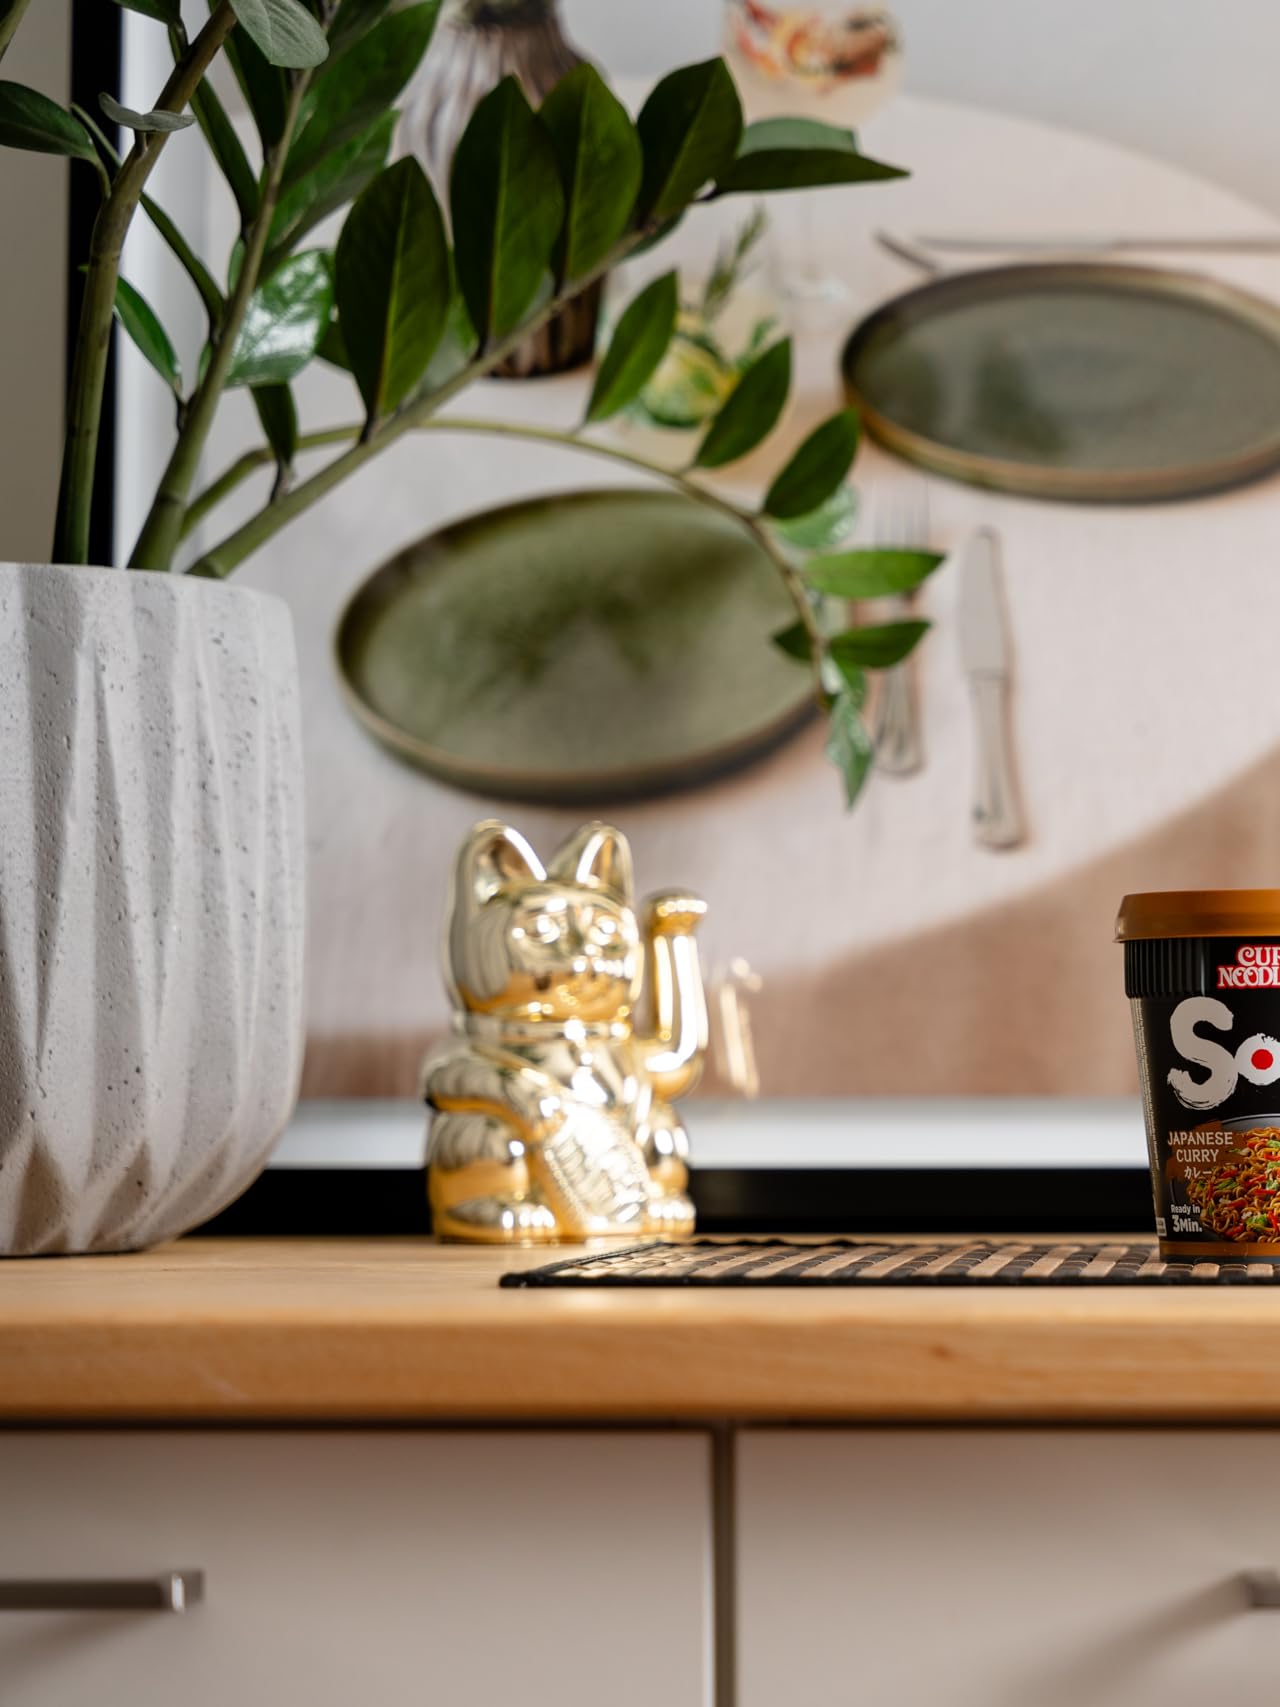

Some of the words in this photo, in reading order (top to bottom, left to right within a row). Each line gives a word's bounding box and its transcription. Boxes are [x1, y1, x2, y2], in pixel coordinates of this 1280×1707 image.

[1167, 1131, 1234, 1146] JAPANESE
[1176, 1149, 1219, 1163] CURRY
[1184, 1165, 1212, 1180] カレー
[1170, 1204, 1191, 1215] Ready
[1192, 1204, 1200, 1213] in
[1172, 1214, 1203, 1233] 3Min.
